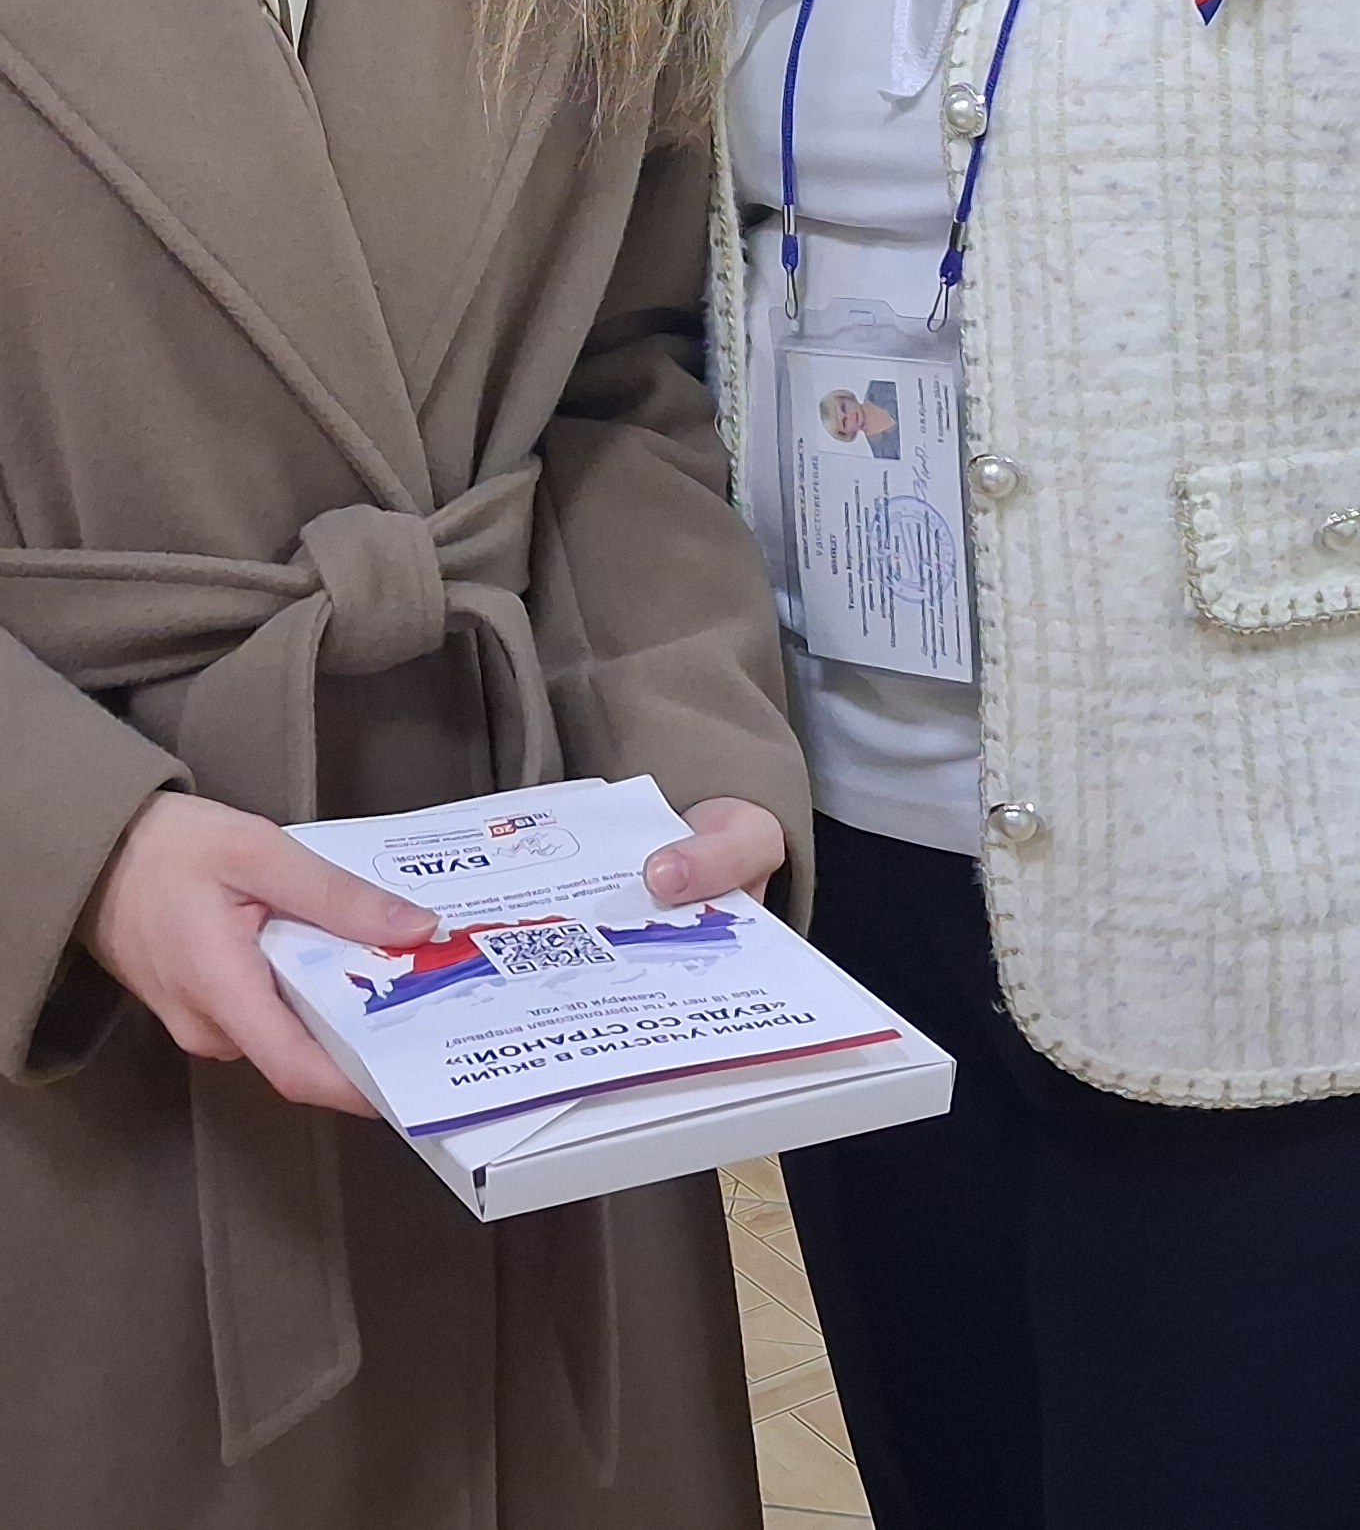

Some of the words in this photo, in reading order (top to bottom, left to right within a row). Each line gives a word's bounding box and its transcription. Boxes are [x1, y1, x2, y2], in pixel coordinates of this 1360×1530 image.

[400, 855, 490, 876] БУДЬ
[590, 991, 666, 1007] Сканируй
[682, 997, 708, 1006] лет
[687, 1001, 786, 1022] «БУДЬ
[636, 1017, 681, 1030] СО
[712, 1013, 816, 1035] Прими
[445, 1023, 628, 1066] СТРАНОЙ!»
[580, 1028, 708, 1056] участие
[554, 1051, 573, 1063] в
[450, 1058, 546, 1086] акции
